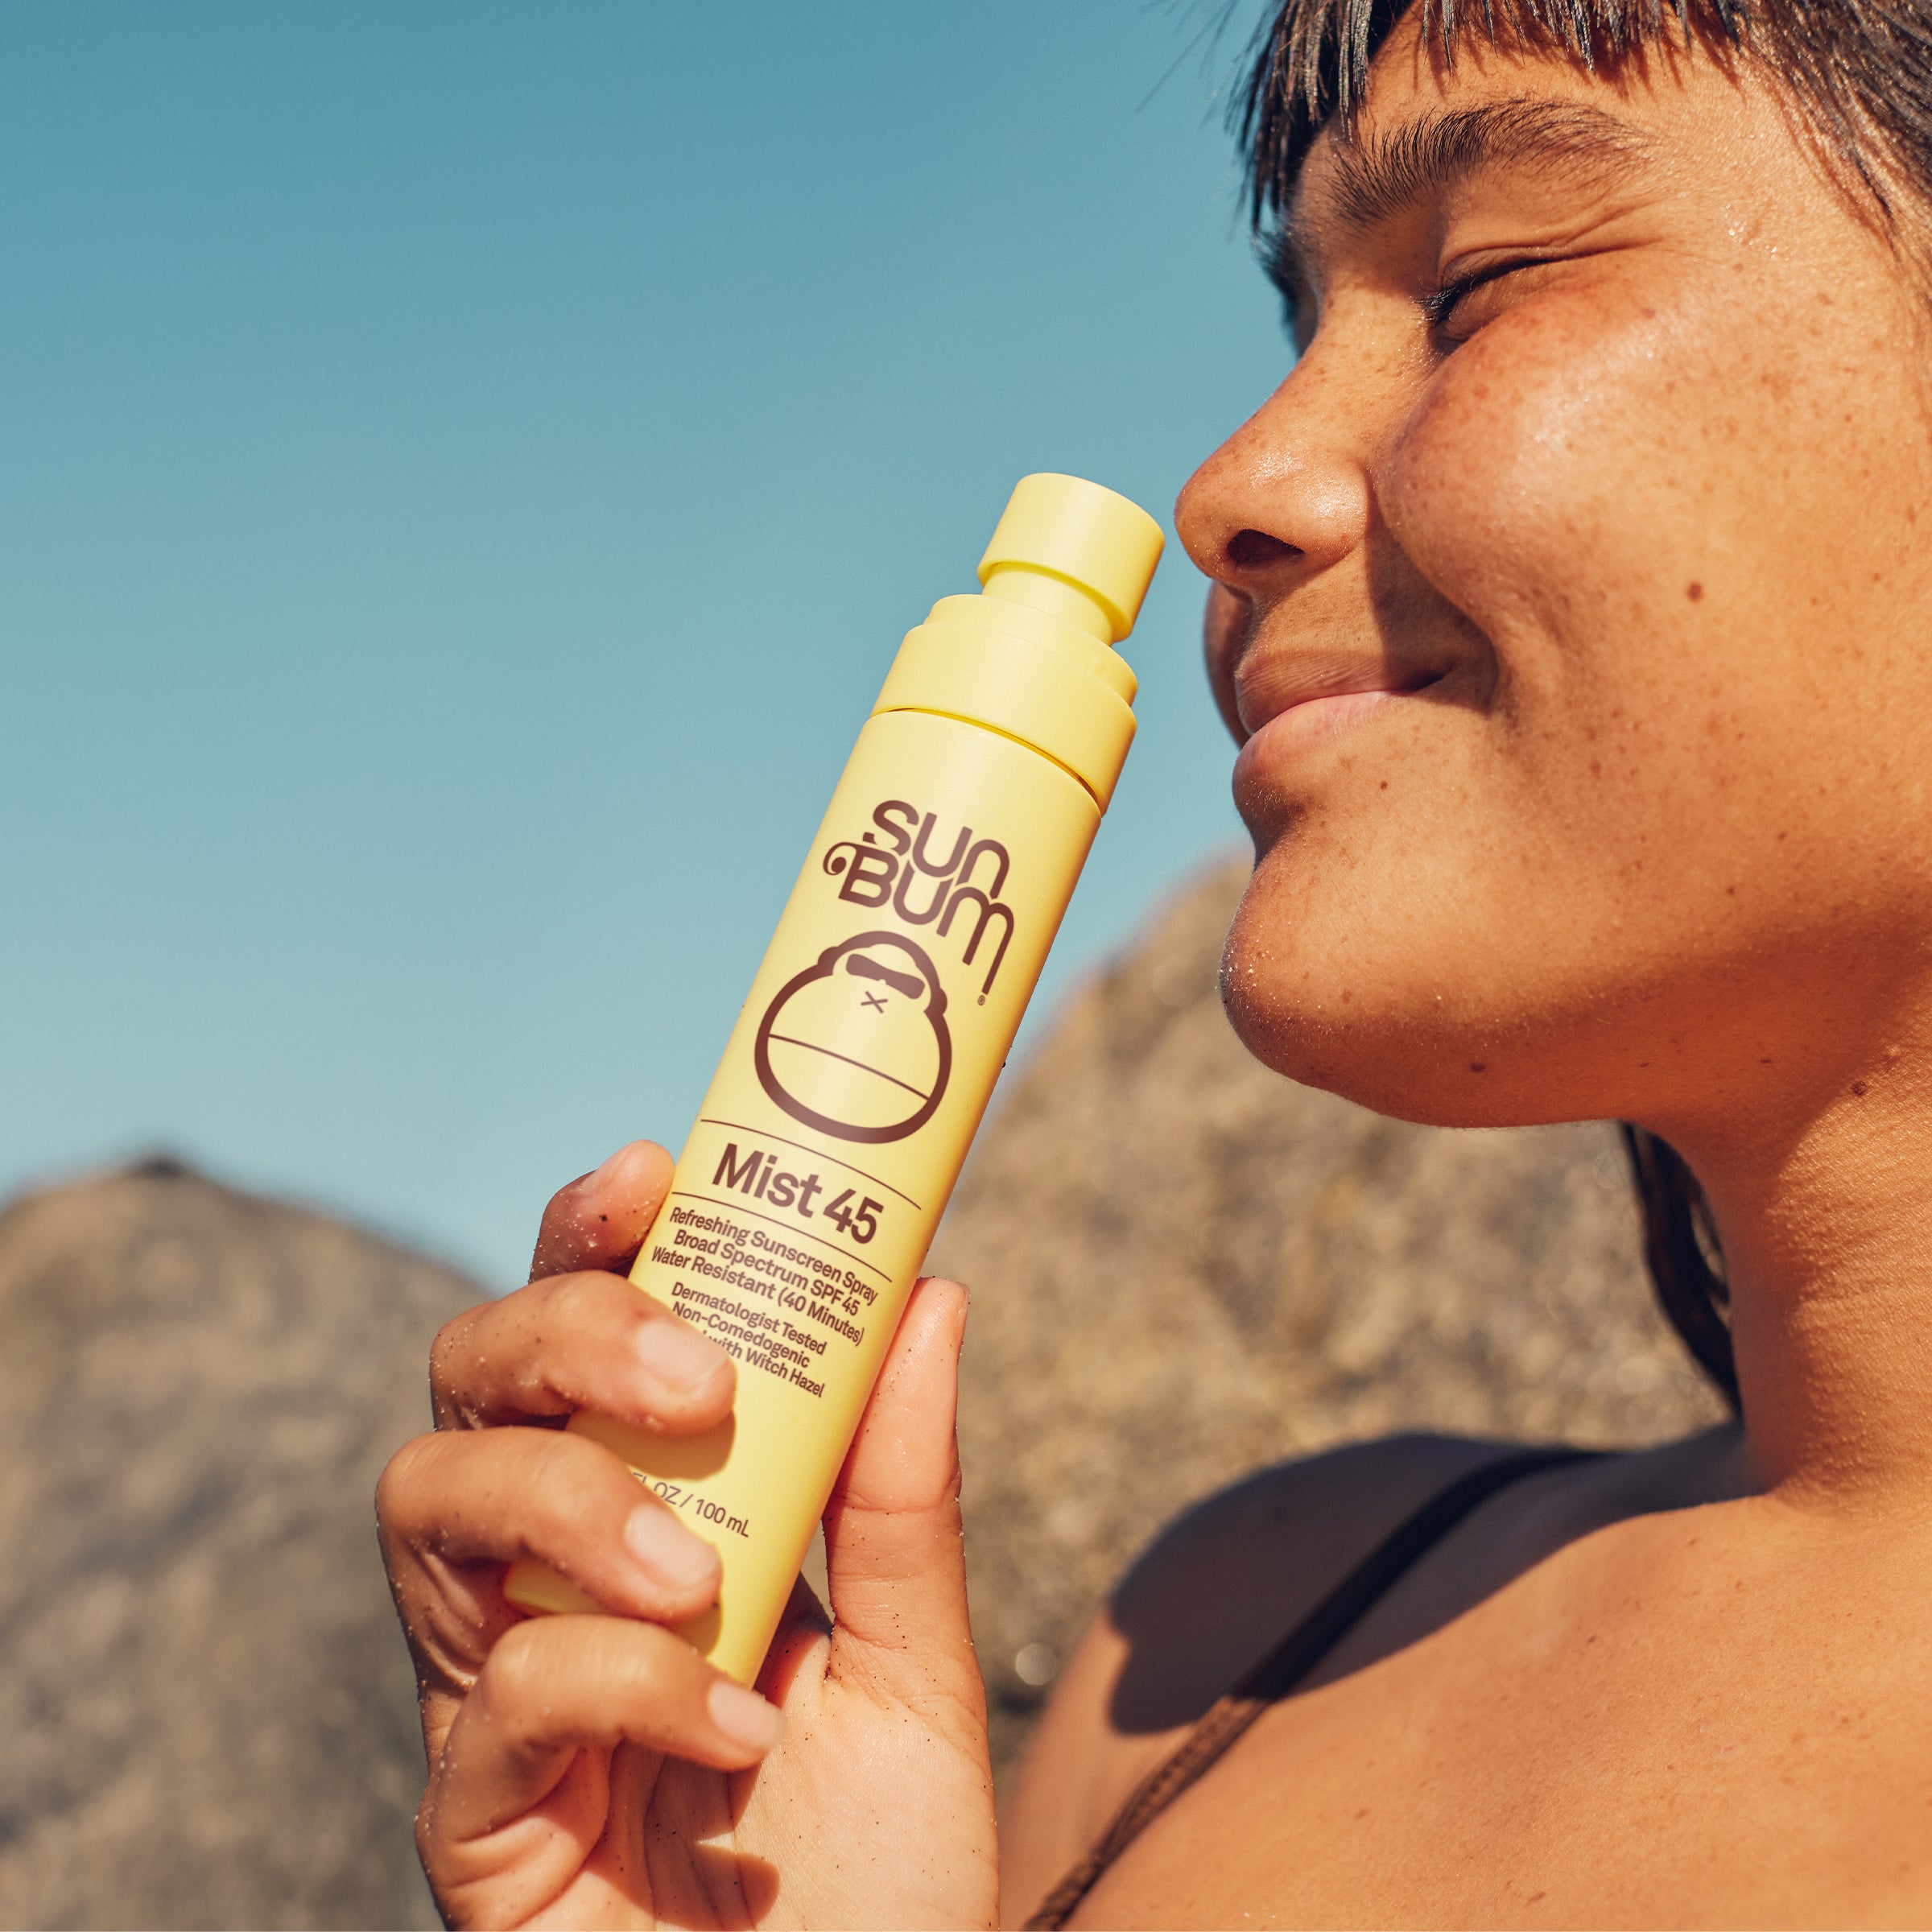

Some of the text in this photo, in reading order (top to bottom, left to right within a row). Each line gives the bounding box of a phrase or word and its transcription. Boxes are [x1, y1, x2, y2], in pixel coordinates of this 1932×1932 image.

[712, 1142, 884, 1244] Mist 45
[651, 1245, 865, 1348] Water Resistant (40 Minutes)
[669, 1206, 878, 1307] Refreshing Sunscreen Spray
[674, 1228, 861, 1316] Broad Spectrum SPF 45
[671, 1282, 828, 1356] Dermatologist Tested
[672, 1301, 811, 1368] Non-Comedogenic
[708, 1335, 825, 1397] ith Witch Hazel
[696, 1498, 726, 1524] 100
[726, 1515, 749, 1538] mL
